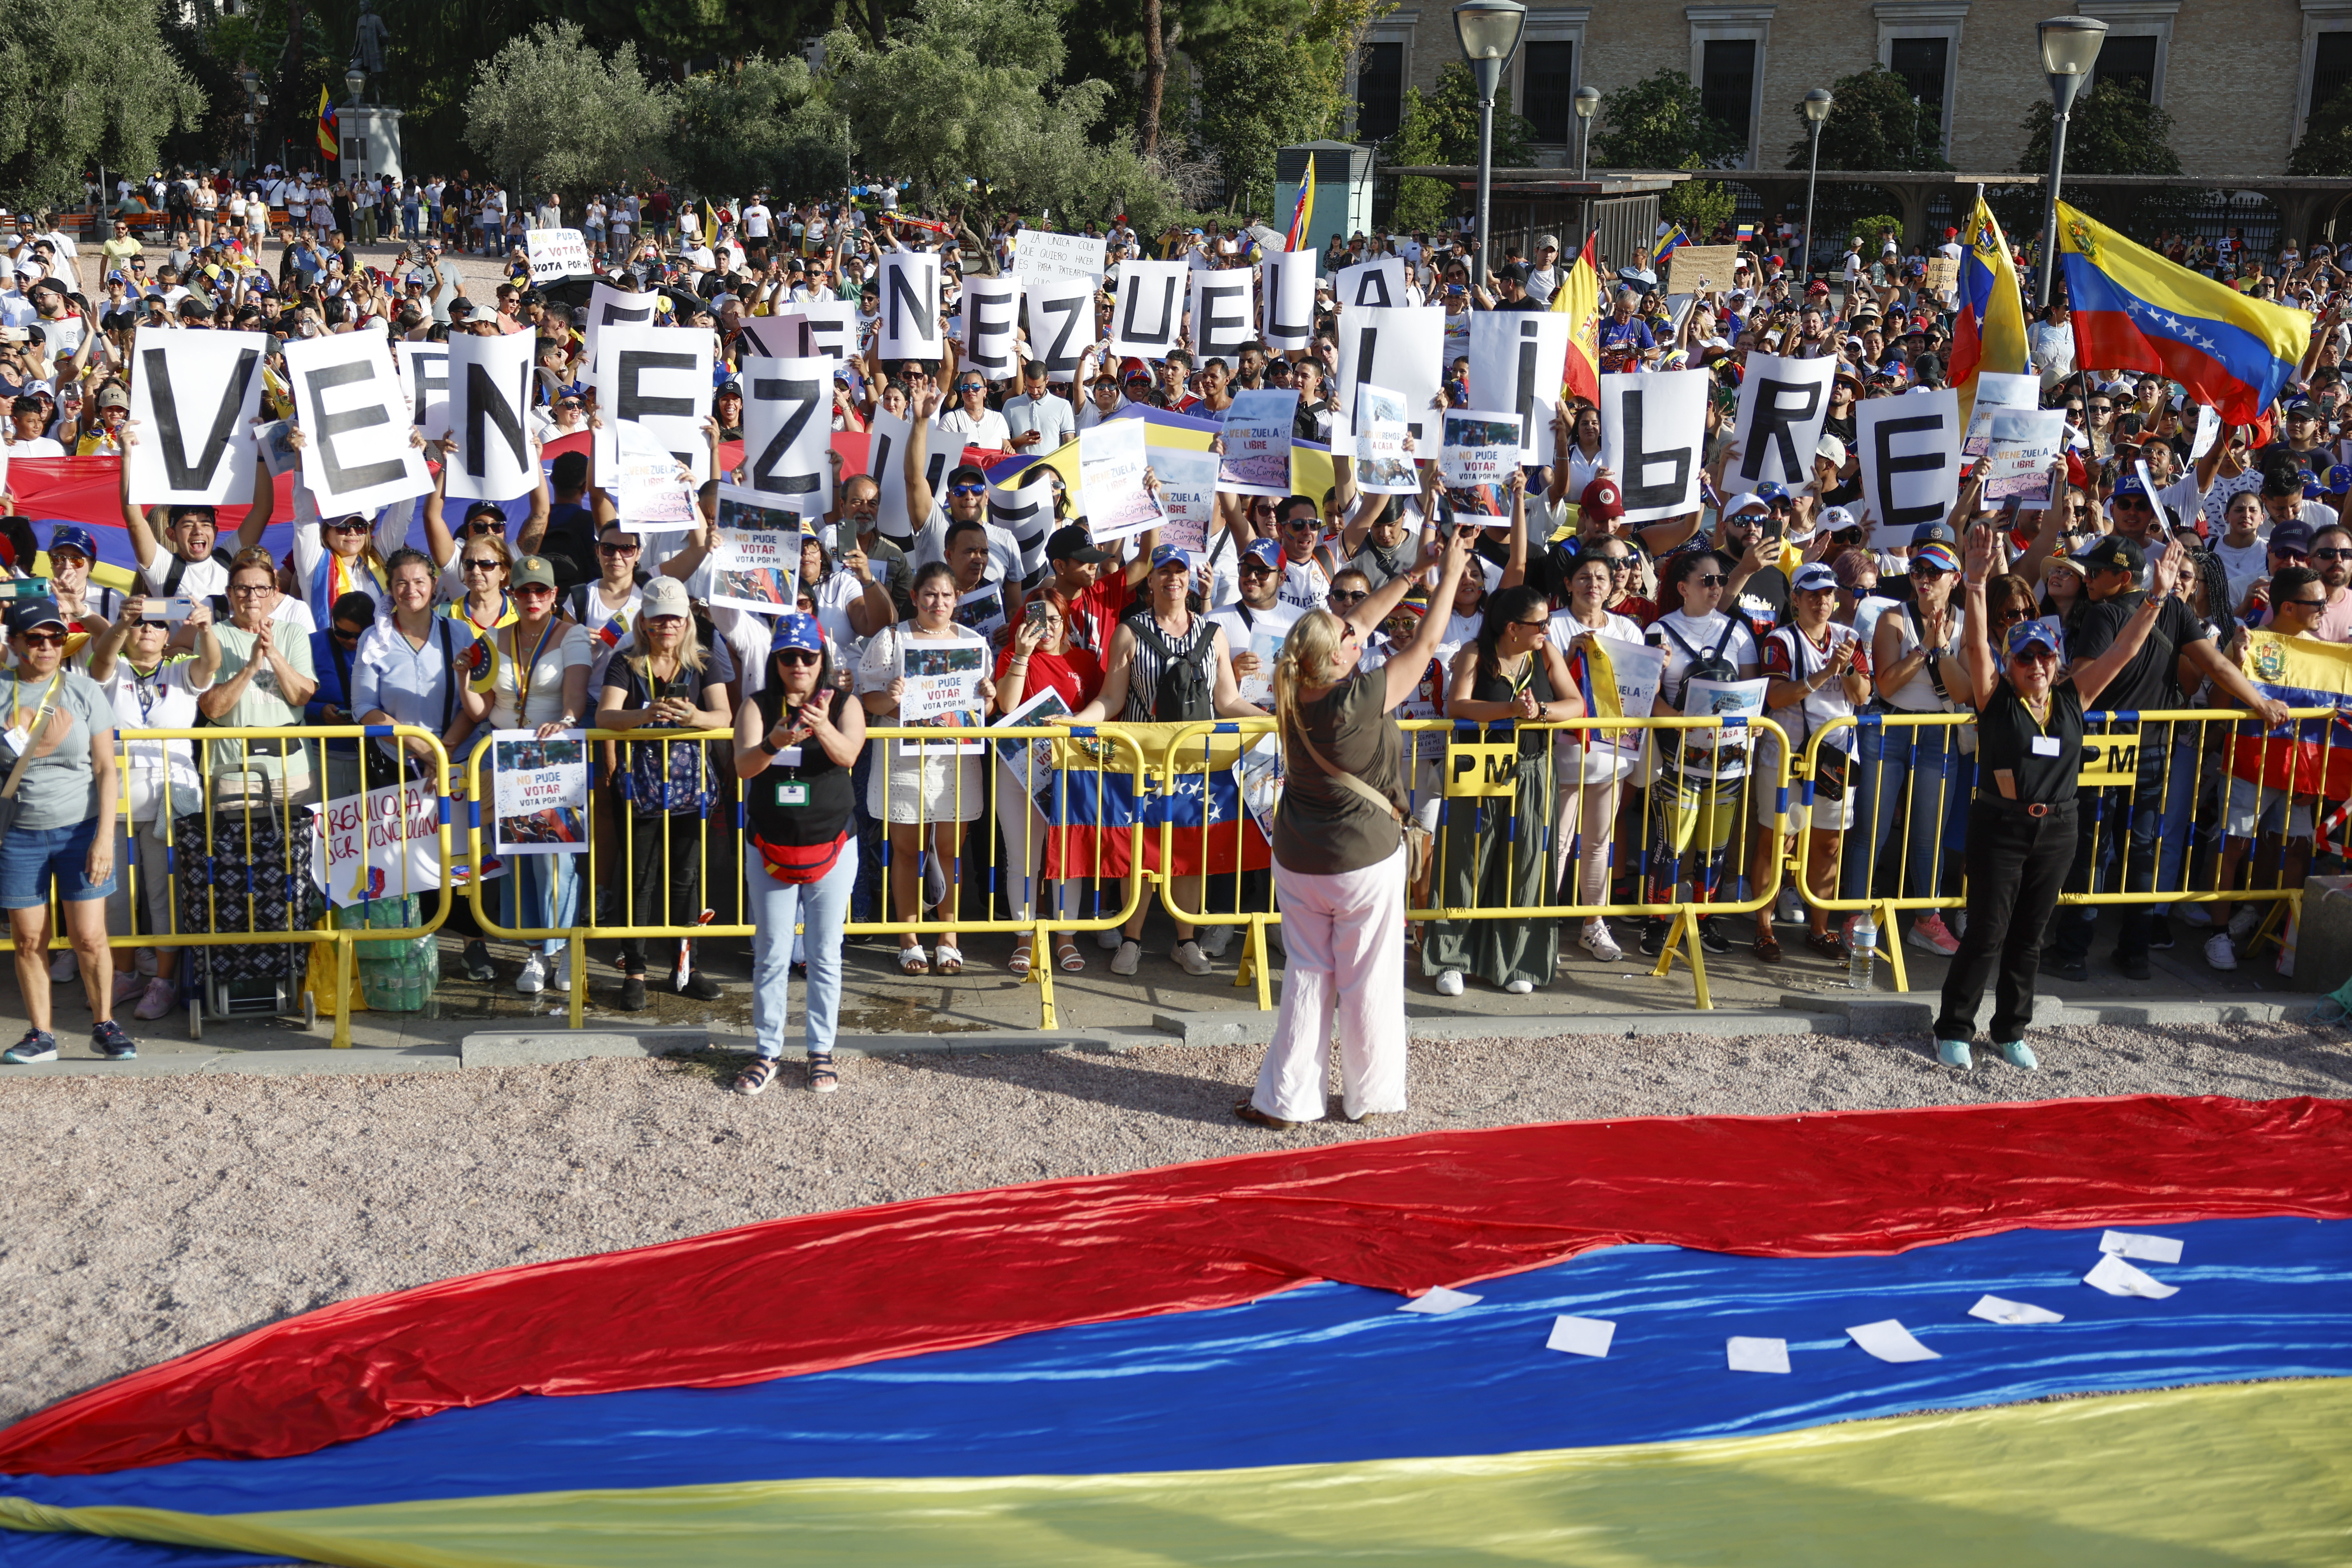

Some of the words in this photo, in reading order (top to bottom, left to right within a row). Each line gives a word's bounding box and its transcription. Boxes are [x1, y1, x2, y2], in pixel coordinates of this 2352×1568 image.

[531, 233, 548, 244] NO
[557, 232, 578, 240] PUDE
[1031, 233, 1040, 244] LA
[1048, 234, 1070, 247] ÚNICA
[1078, 241, 1094, 251] COLA
[548, 246, 582, 257] VOTAR
[1020, 245, 1034, 257] QUE
[1040, 249, 1067, 261] QUIERO
[1075, 255, 1094, 265] HACER
[533, 261, 562, 272] VOTA
[568, 260, 581, 269] POR
[1018, 259, 1028, 269] ES
[1037, 261, 1052, 272] PARA
[1058, 265, 1089, 278] PATEARTE
[1929, 264, 1956, 273] VENEZUELA
[889, 264, 934, 341] N
[1268, 264, 1309, 338] L
[1121, 275, 1176, 344] U
[1199, 285, 1244, 357] E
[969, 292, 1012, 367] E
[1042, 296, 1086, 371] Z
[143, 348, 260, 491] V
[466, 359, 530, 478] N
[305, 359, 408, 495] E
[1230, 428, 1279, 438] VENEZUELA
[1740, 378, 1822, 484] R
[753, 378, 821, 494] Z
[1364, 430, 1400, 440] VOLVEREMOS
[1244, 441, 1267, 450] LIBRE
[1378, 442, 1393, 450] CASA
[1459, 451, 1472, 460] NO
[1475, 451, 1498, 460] PUDE
[1998, 448, 2048, 460] VENEZUELA
[629, 464, 676, 475] VENEZUELA
[1464, 462, 1496, 471] VOTAR
[1875, 414, 1946, 527] E
[2012, 460, 2035, 469] LIBRE
[1090, 462, 1137, 485] VENEZUELA
[644, 478, 665, 487] LIBRE
[1106, 478, 1127, 492] LIBRE
[735, 534, 749, 542] NO
[753, 534, 777, 544] PUDE
[741, 544, 775, 554] VOTAR
[657, 586, 674, 600] M
[921, 680, 934, 690] NO
[938, 677, 961, 688] PUDE
[927, 688, 959, 700] VOTAR
[923, 701, 941, 710] VOTA
[516, 775, 531, 786] NO
[535, 772, 560, 784] PUDE
[524, 784, 560, 796] VOTAR
[520, 797, 540, 807] VOTA
